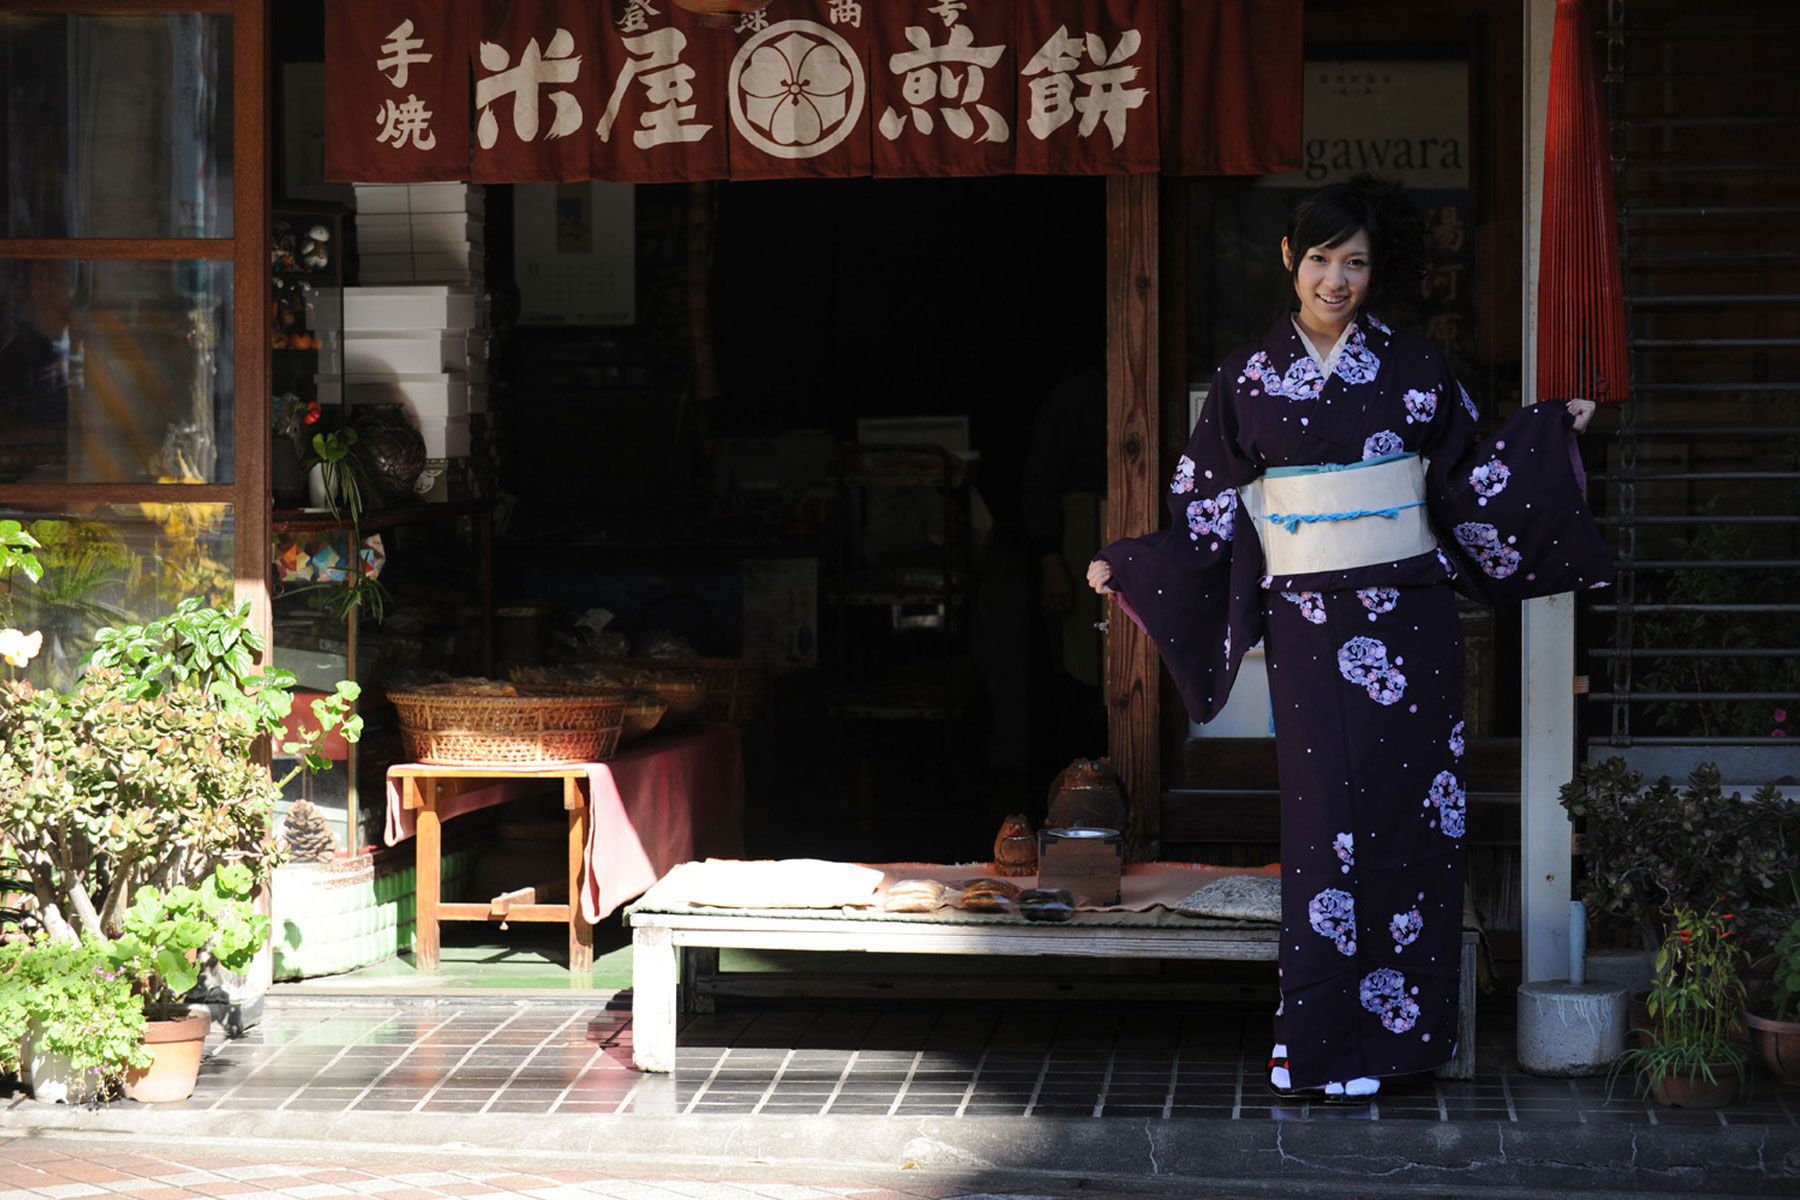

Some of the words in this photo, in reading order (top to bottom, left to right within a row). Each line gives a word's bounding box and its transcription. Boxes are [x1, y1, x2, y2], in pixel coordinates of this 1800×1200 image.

[376, 18, 437, 151] 手焼
[475, 27, 714, 150] 米屋
[878, 23, 1151, 151] 煎餅
[1305, 136, 1463, 182] gawara
